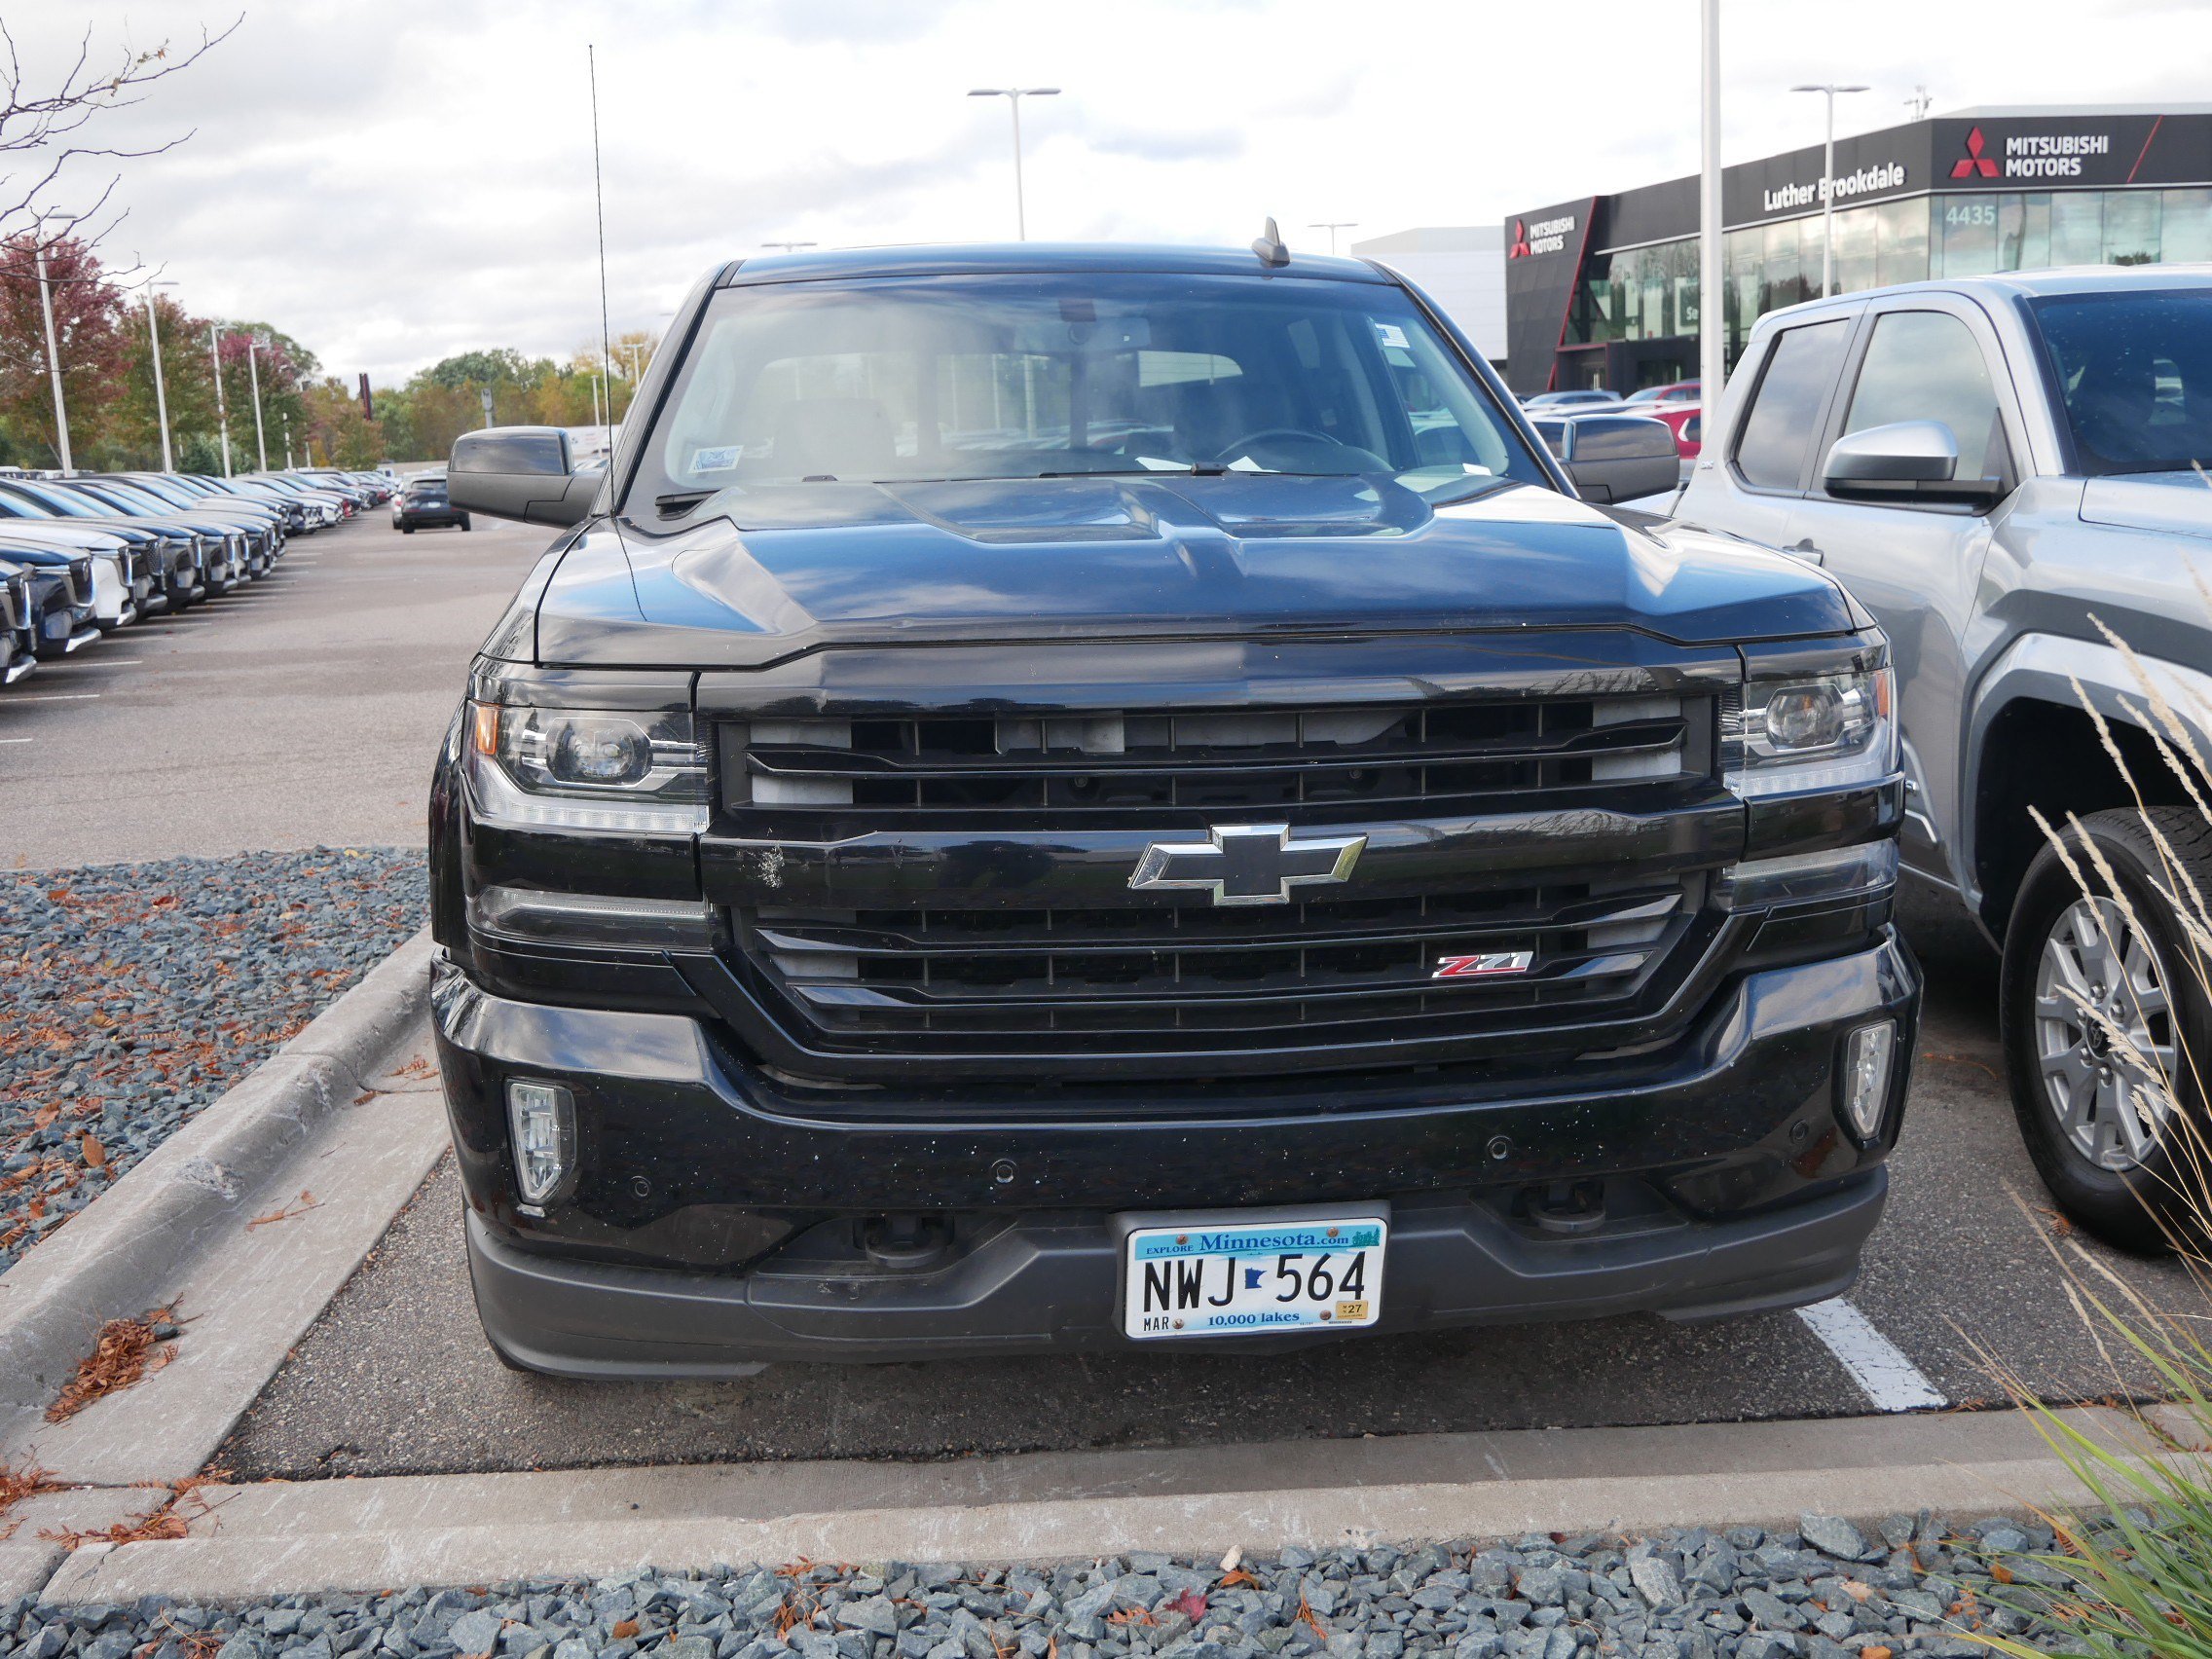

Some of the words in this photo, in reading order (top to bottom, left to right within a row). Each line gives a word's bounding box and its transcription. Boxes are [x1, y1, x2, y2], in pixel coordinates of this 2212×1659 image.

[2006, 135, 2109, 156] MITSUBISHI
[2006, 157, 2082, 177] MOTORS
[1764, 182, 1816, 211] Luther
[1818, 162, 1905, 201] Brookdale
[1946, 205, 1995, 225] 4435
[1530, 215, 1575, 240] MITSUBISHI
[1530, 235, 1565, 255] MOTORS
[1432, 951, 1533, 977] Z71
[1146, 1244, 1194, 1255] EXPLORE
[1143, 1256, 1236, 1312] NWJ
[1274, 1251, 1366, 1303] 564
[1207, 1314, 1256, 1327] 10,000
[1261, 1311, 1300, 1324] lakes
[1347, 1304, 1362, 1314] 27
[1143, 1316, 1169, 1332] MAR
